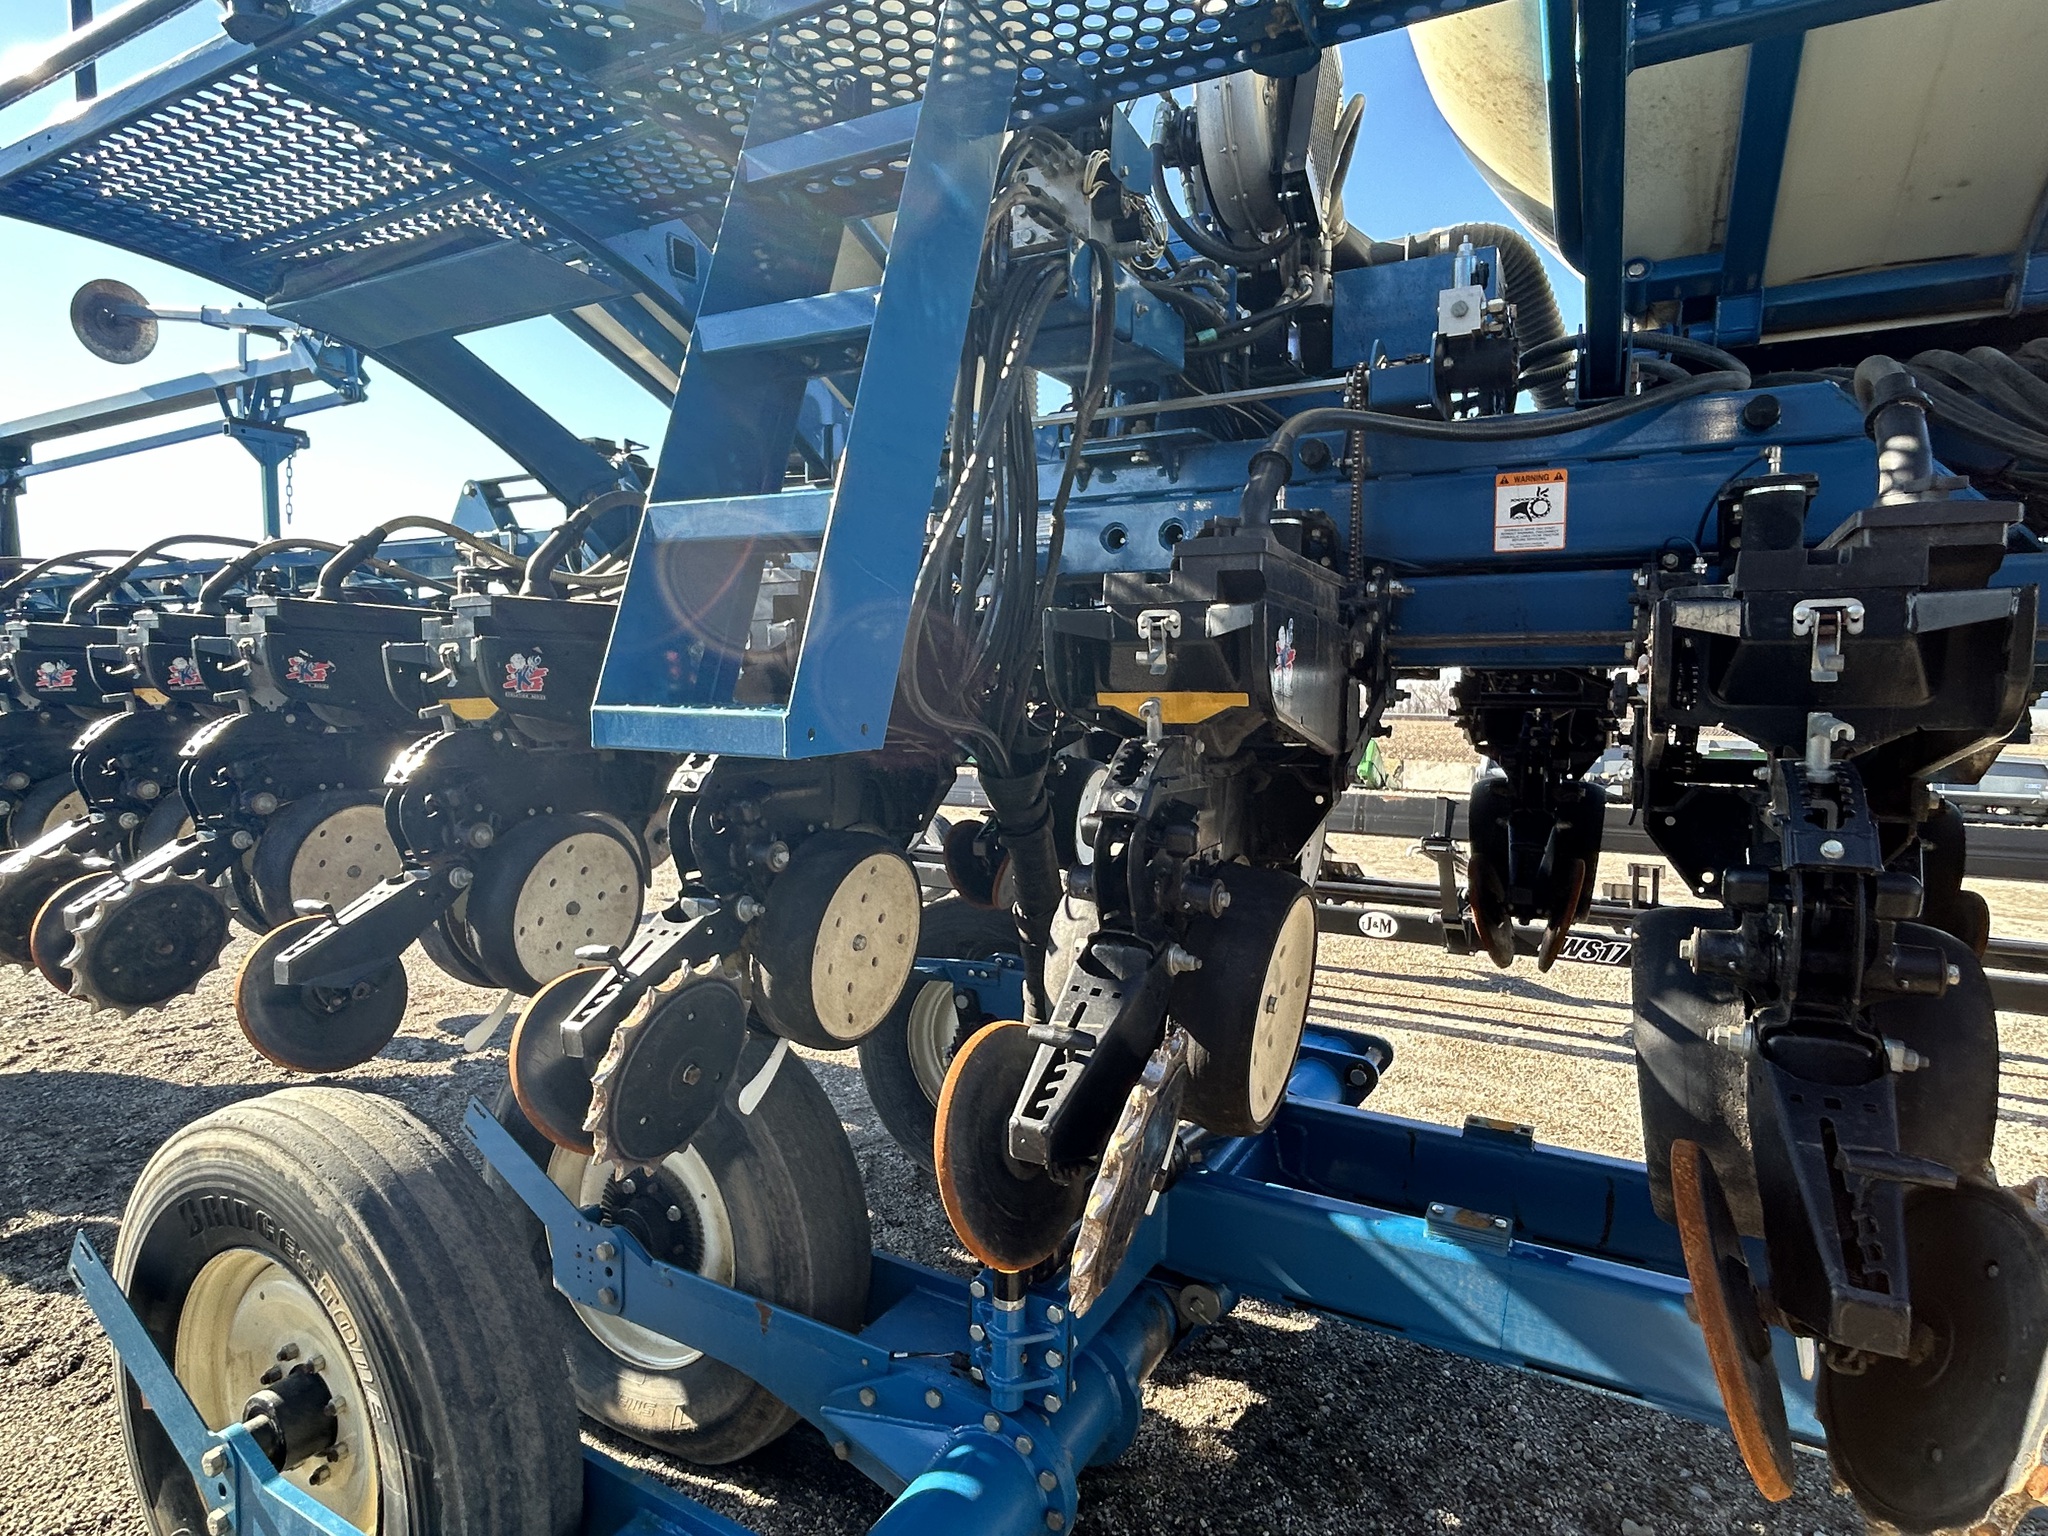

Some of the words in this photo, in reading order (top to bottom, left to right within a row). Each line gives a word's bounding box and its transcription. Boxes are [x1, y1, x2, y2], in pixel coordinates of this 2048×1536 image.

[1514, 473, 1550, 483] WARNING
[1361, 916, 1392, 934] J&M
[177, 1195, 388, 1424] BRIDGESTONE
